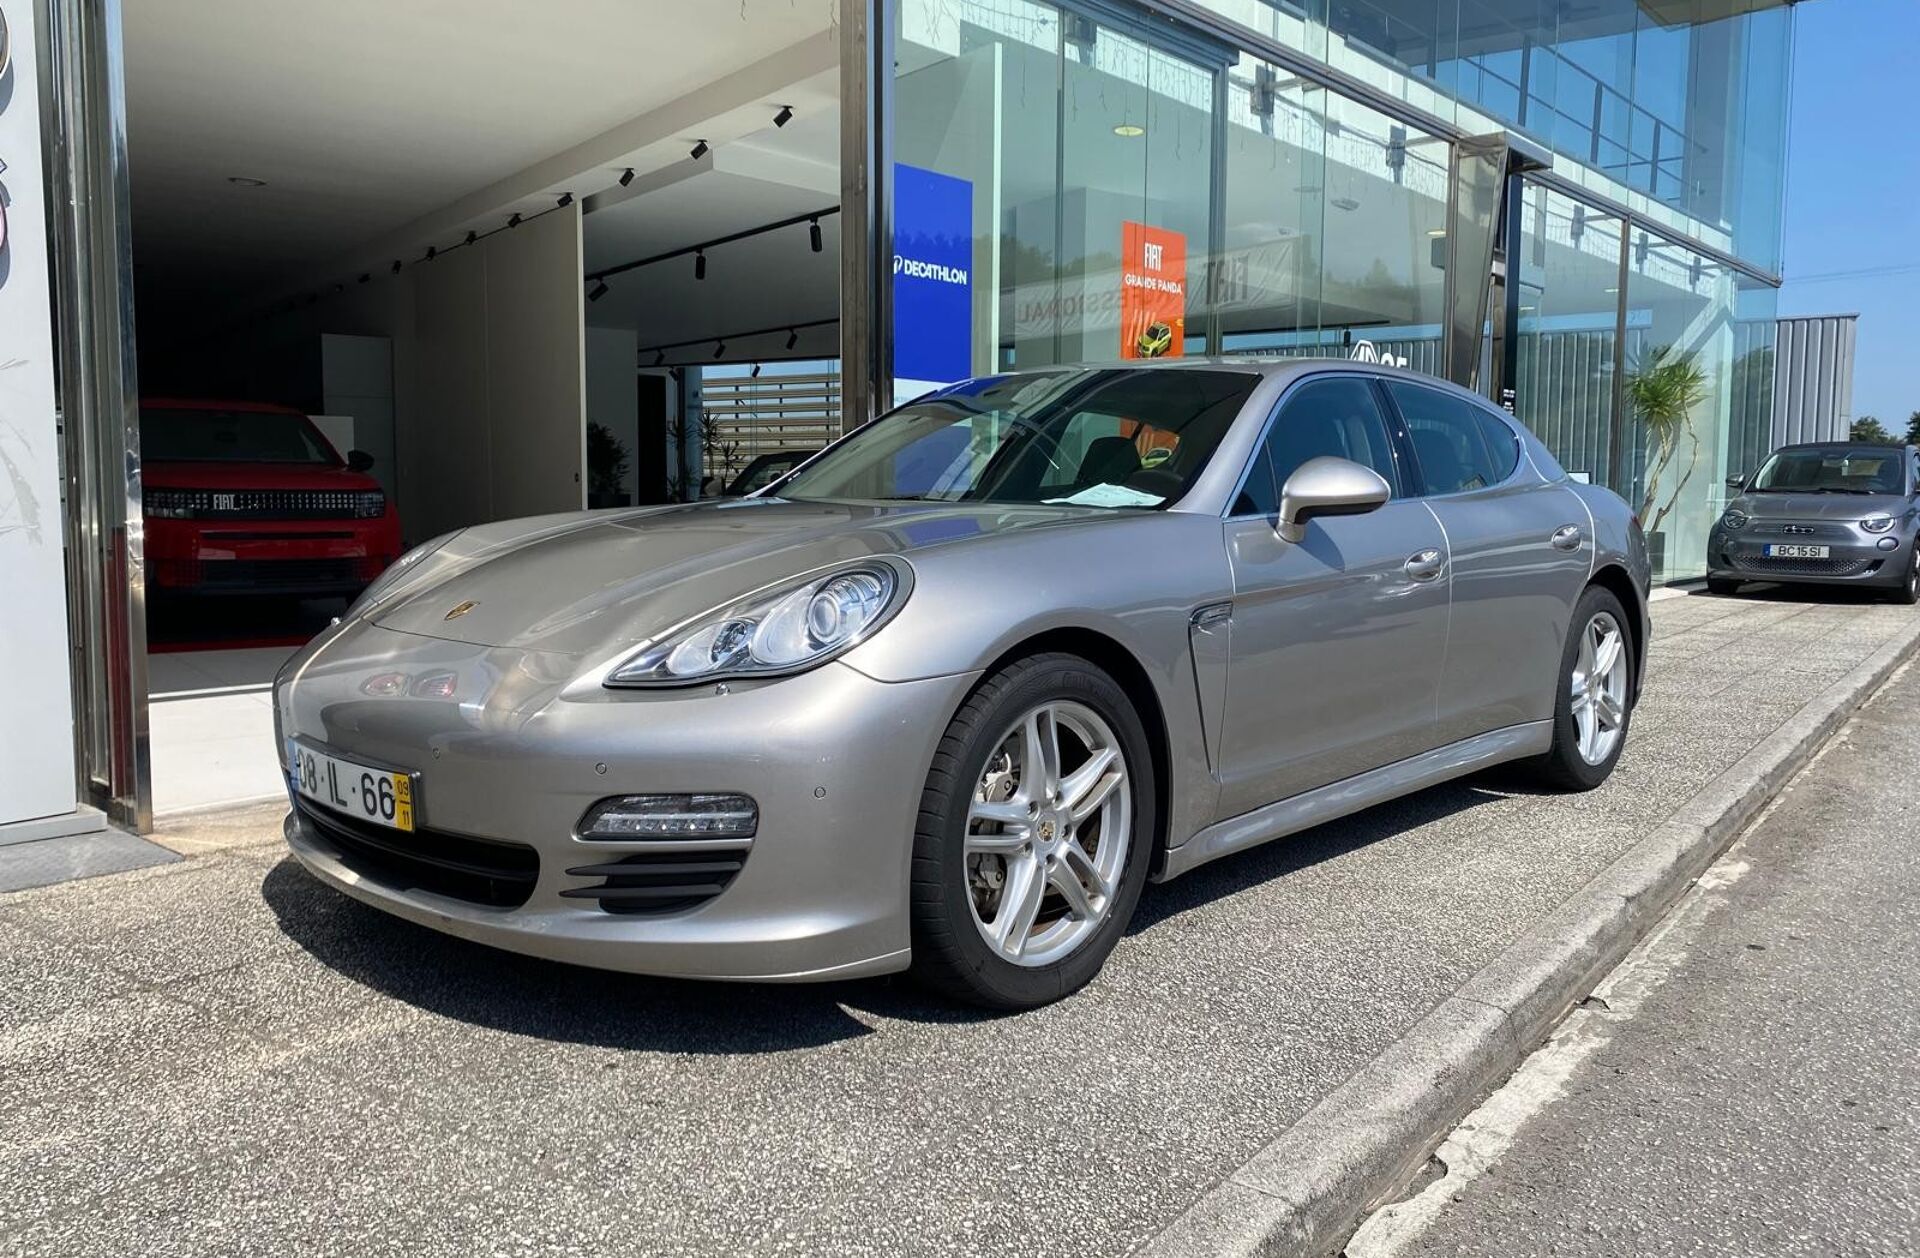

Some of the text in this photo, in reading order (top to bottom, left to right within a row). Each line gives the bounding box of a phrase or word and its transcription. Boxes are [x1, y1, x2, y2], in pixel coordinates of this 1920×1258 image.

[1144, 242, 1163, 273] FIAT
[904, 258, 967, 285] DECATHLON
[1125, 273, 1182, 295] GRANDE PANDA
[213, 494, 235, 510] FIAT
[1779, 546, 1795, 555] BC
[1798, 547, 1807, 556] 15
